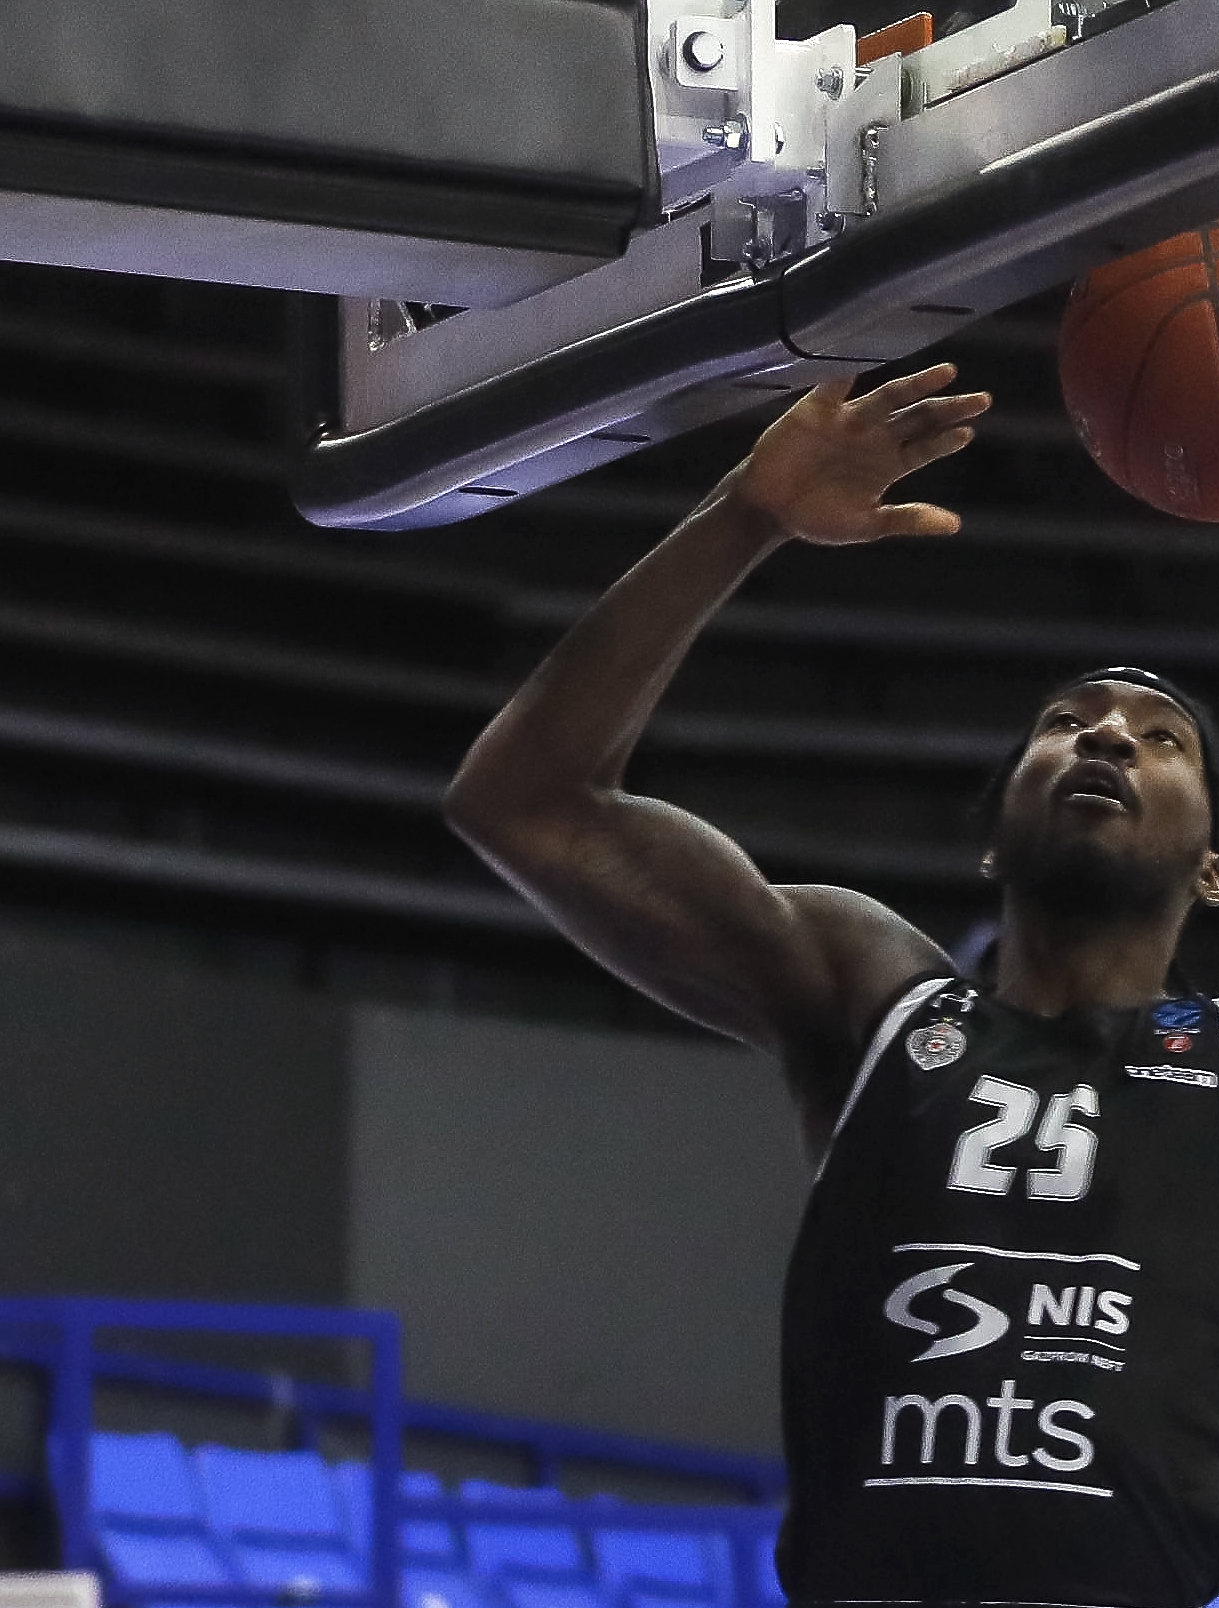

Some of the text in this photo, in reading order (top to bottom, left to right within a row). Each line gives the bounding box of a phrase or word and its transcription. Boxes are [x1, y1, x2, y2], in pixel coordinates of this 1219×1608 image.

[946, 1074, 1102, 1202] 25
[1026, 1283, 1134, 1335] NIS
[881, 1379, 1096, 1472] mts
